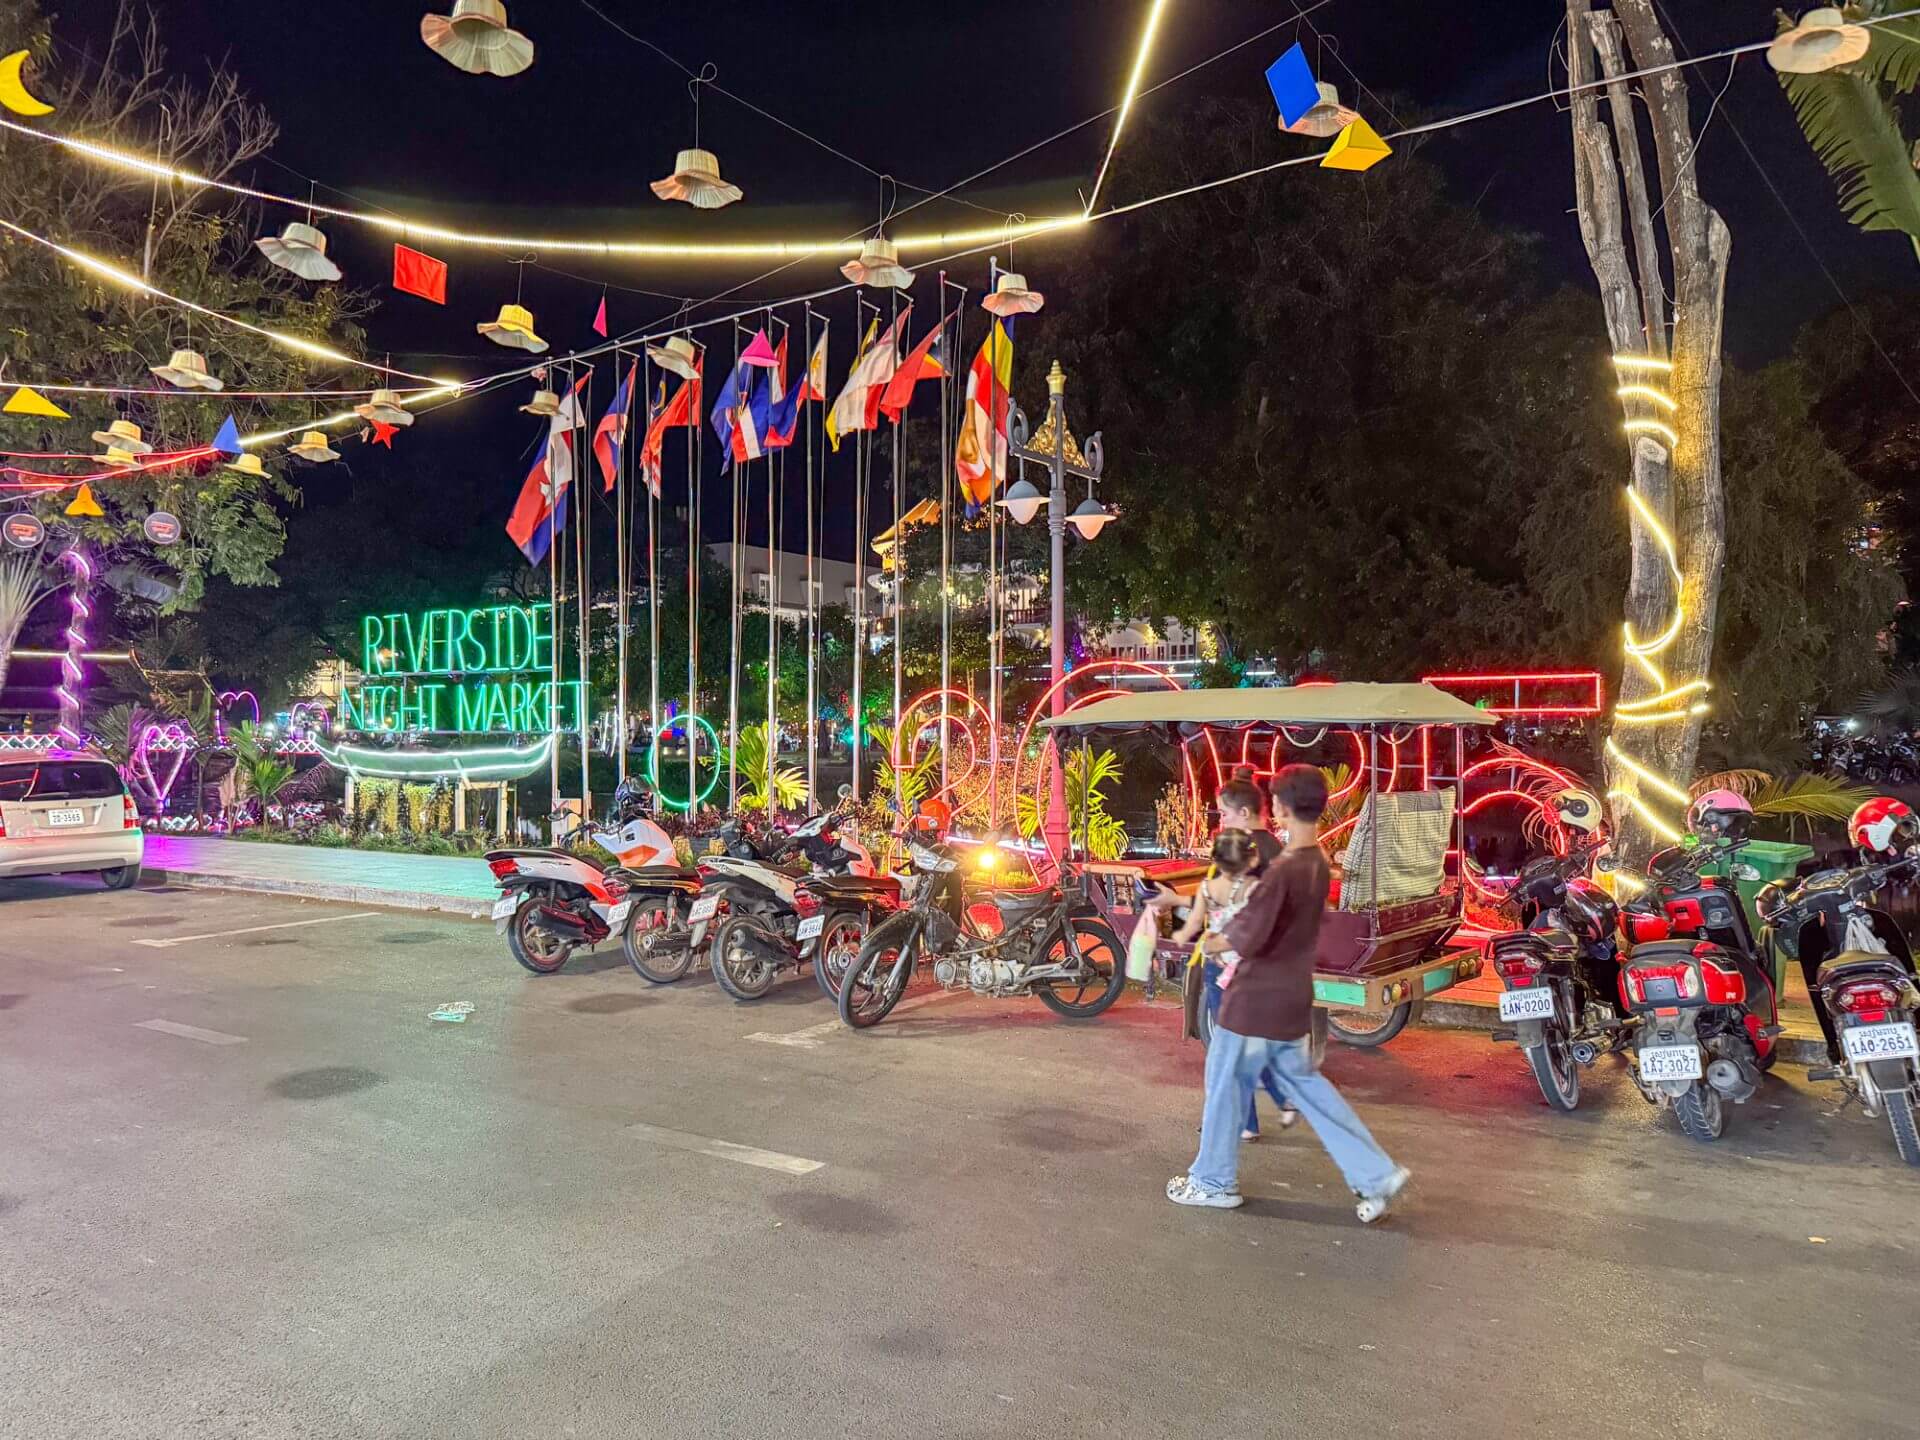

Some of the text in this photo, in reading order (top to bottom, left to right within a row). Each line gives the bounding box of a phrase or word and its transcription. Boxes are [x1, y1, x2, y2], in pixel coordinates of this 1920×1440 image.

[364, 604, 553, 676] RIVERSIDE
[341, 681, 592, 732] NIGHT MARKET
[1502, 999, 1551, 1015] 1AN-0200
